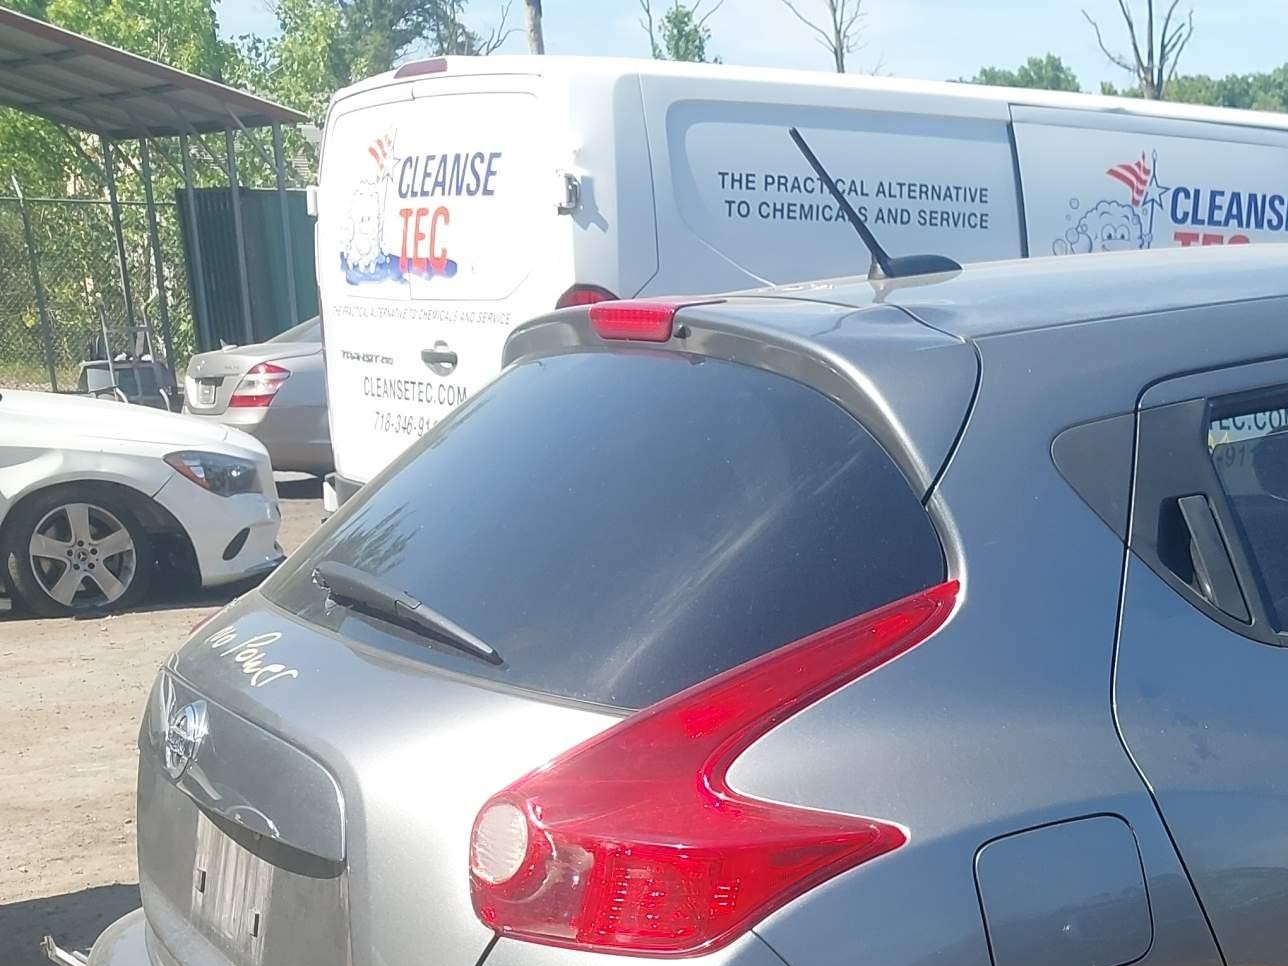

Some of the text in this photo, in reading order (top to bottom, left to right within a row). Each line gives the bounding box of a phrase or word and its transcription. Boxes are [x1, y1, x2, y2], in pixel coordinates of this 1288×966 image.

[398, 152, 502, 198] CLEANSE
[718, 171, 756, 191] THE
[875, 181, 990, 204] ALTERNATIVE
[725, 199, 750, 218] TO
[874, 207, 911, 226] AND
[917, 209, 989, 230] SERVICE
[398, 206, 450, 274] TEC
[477, 311, 512, 325] SERVICE
[363, 376, 467, 406] CLEANSETEC.COM
[374, 411, 438, 437] 718-346-91
